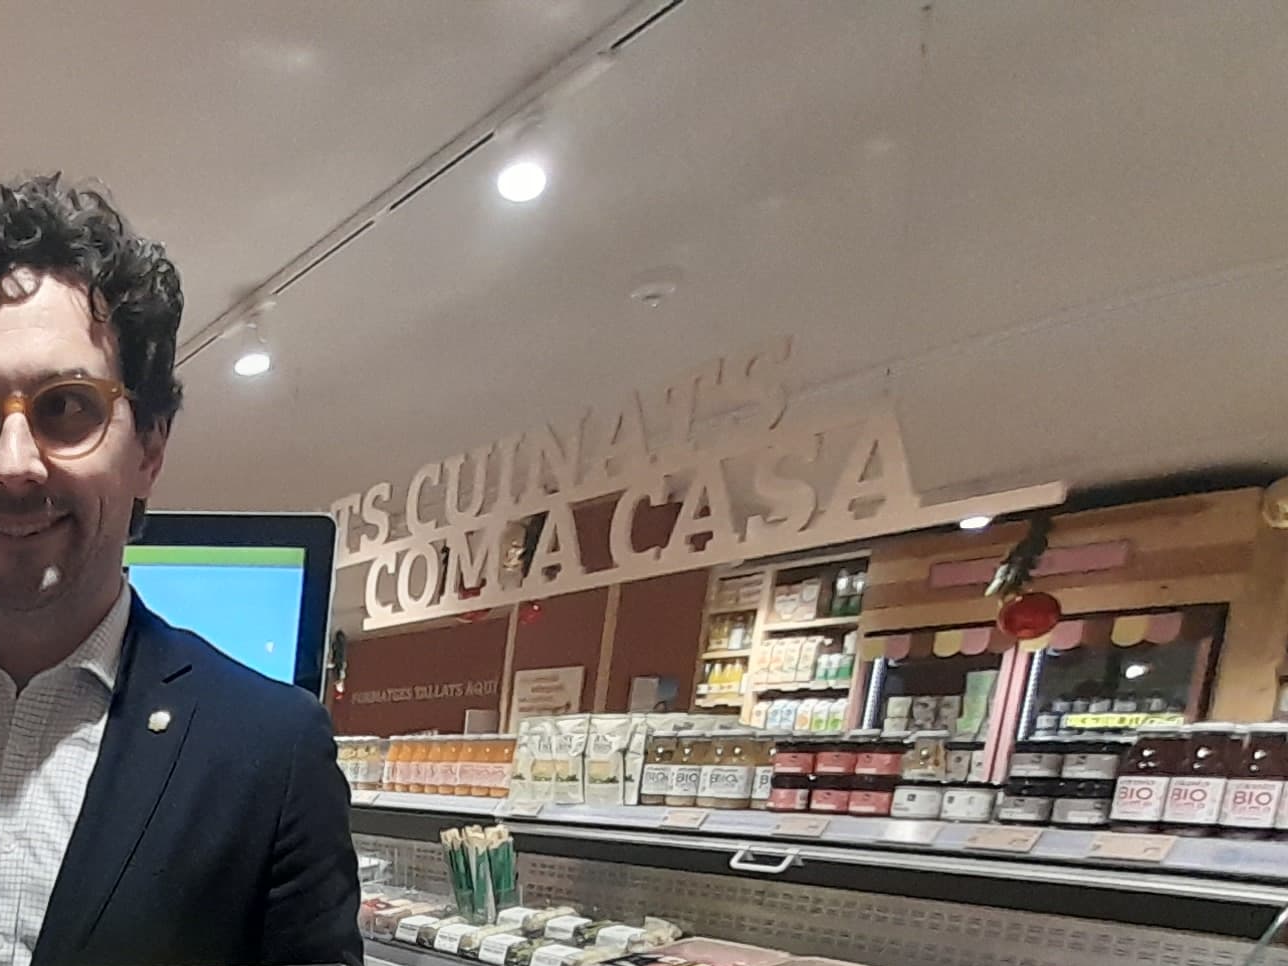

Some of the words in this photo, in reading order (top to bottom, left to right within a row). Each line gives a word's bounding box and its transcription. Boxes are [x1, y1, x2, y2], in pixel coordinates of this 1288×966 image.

[610, 393, 924, 562] CASA
[1170, 788, 1207, 802] BIO
[1232, 790, 1272, 806] BIO
